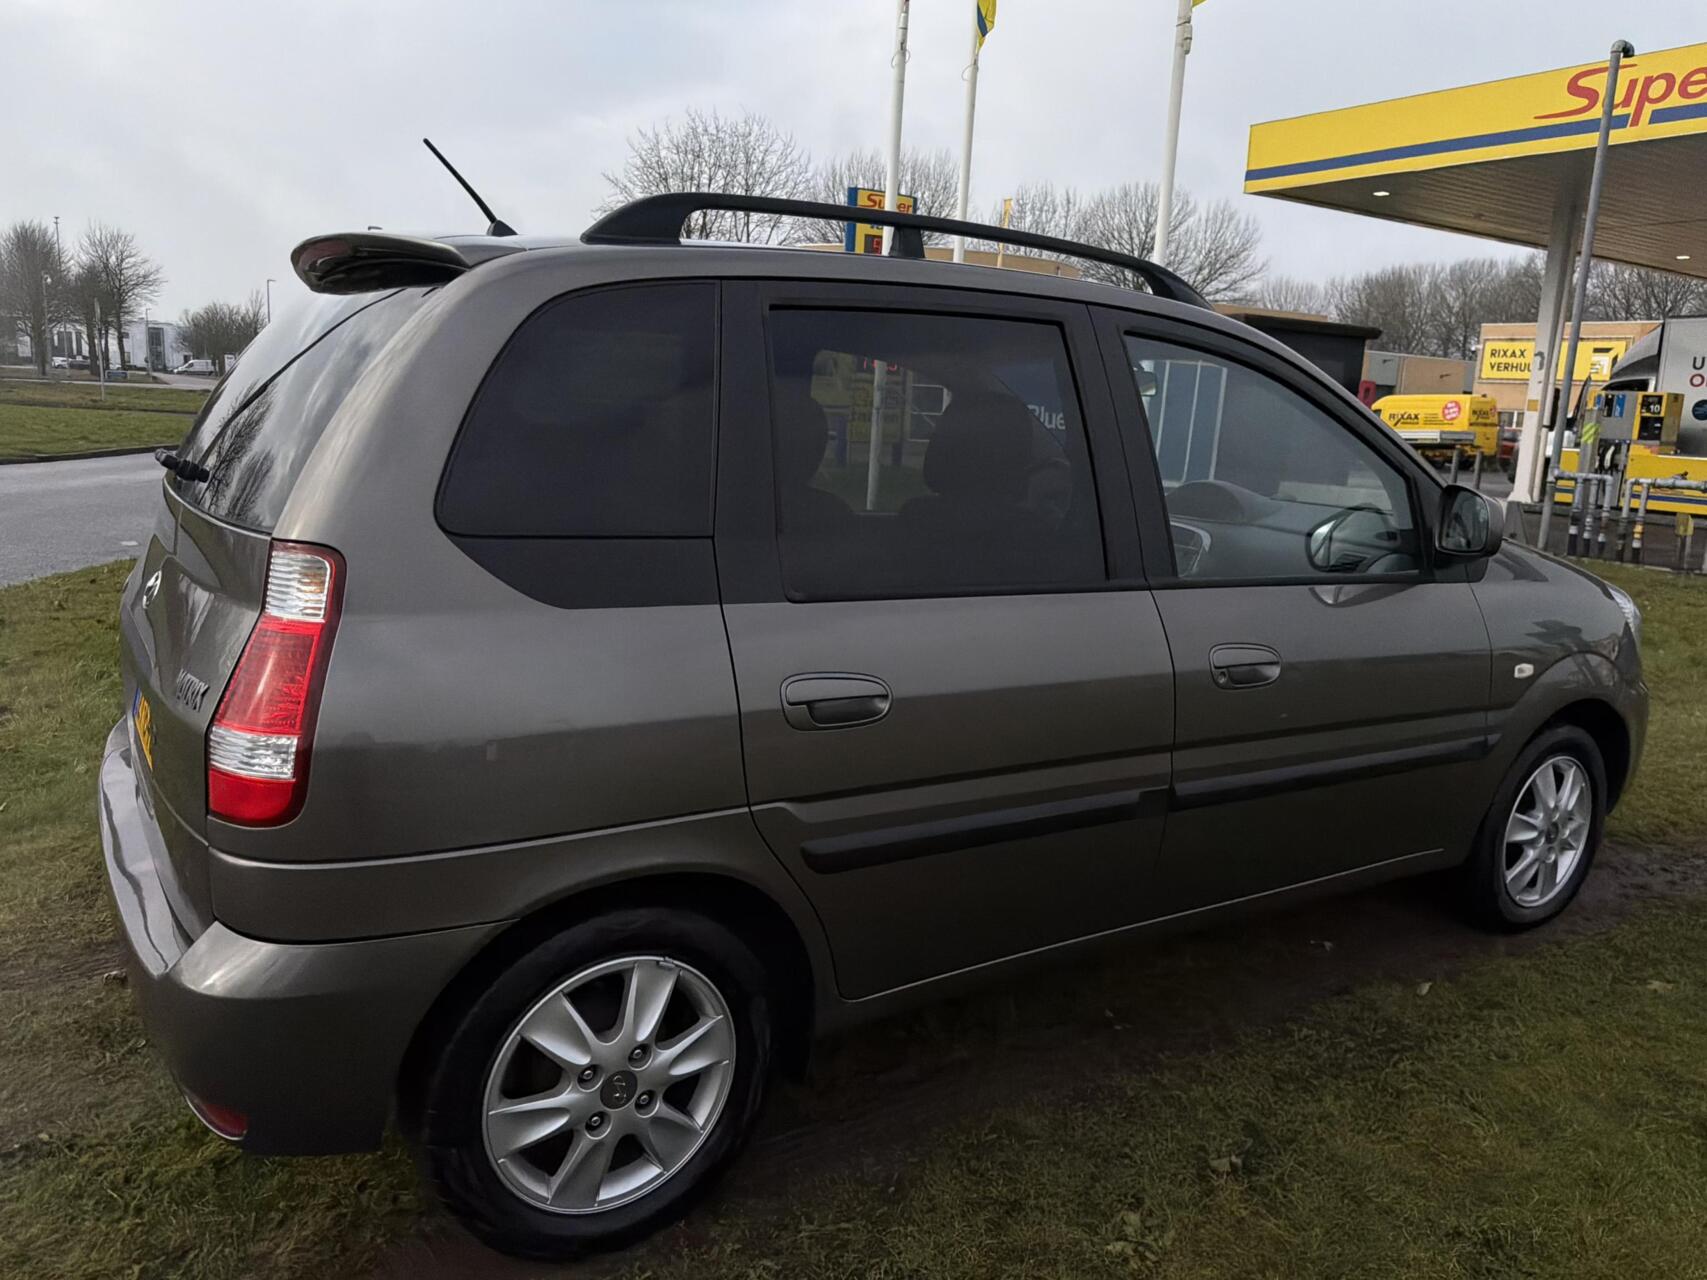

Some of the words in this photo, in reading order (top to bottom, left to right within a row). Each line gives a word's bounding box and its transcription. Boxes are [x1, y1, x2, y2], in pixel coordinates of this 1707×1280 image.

[858, 193, 912, 213] Suer
[1490, 349, 1527, 358] RIXAX
[1689, 373, 1707, 388] O
